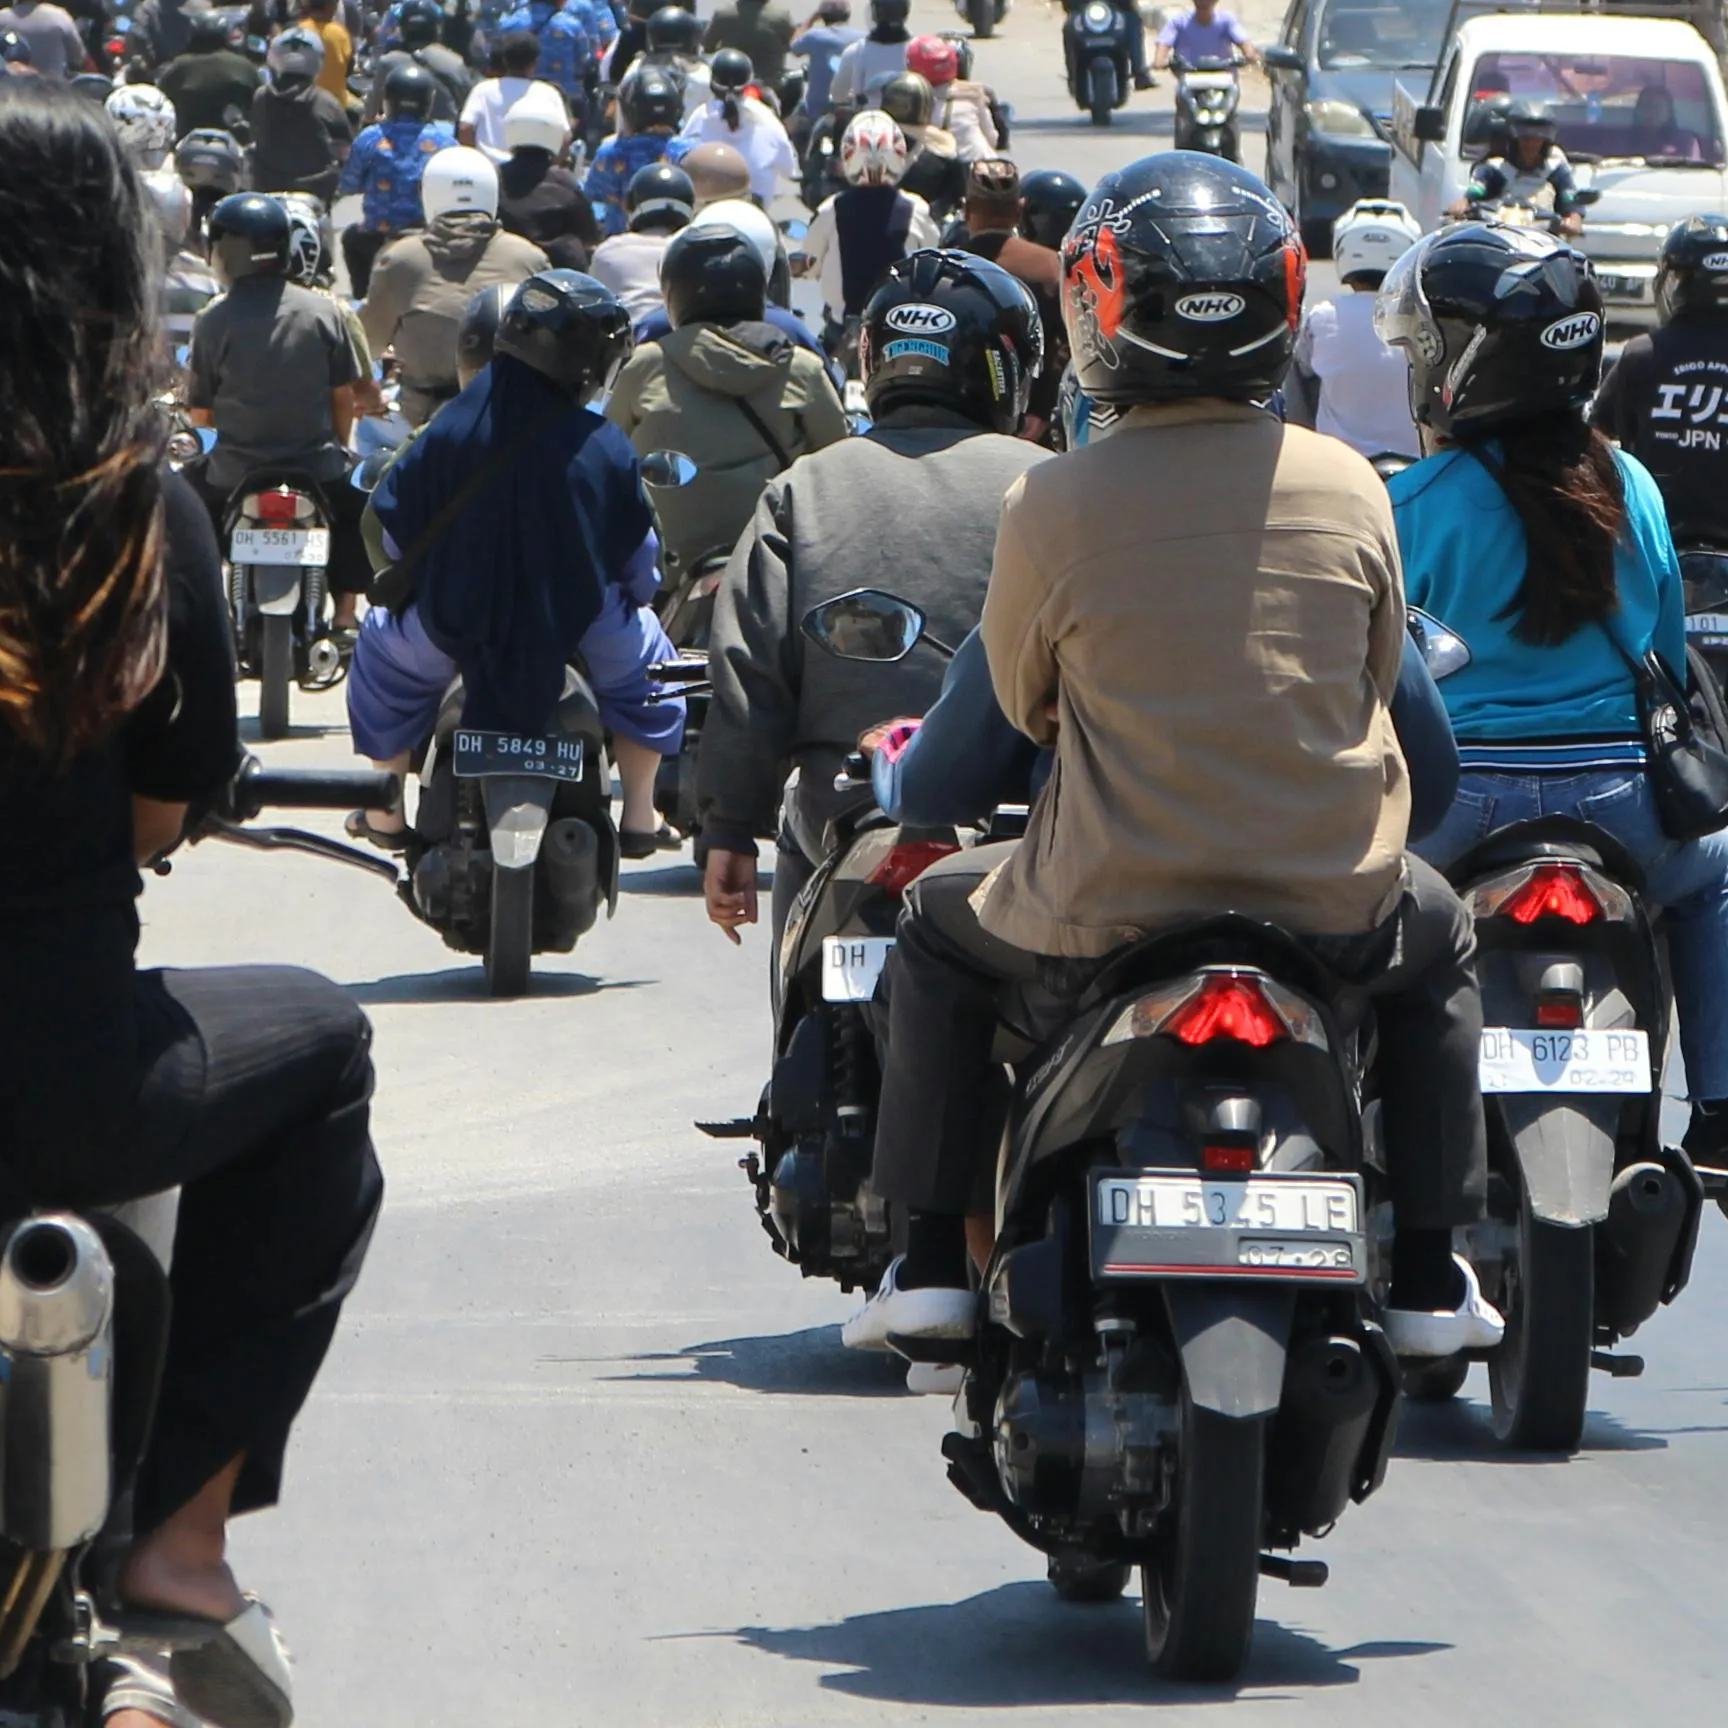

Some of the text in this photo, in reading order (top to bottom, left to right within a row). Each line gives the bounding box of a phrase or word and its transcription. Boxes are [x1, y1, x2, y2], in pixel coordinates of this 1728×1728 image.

[1184, 297, 1234, 315] NHK
[893, 310, 944, 327] NHK
[1552, 316, 1596, 345] NHK
[1679, 429, 1720, 450] JPN
[262, 531, 298, 546] 5561
[458, 734, 581, 761] DH 5849 HU
[832, 944, 865, 968] DH
[1482, 1032, 1640, 1063] DH 6123 PB
[1110, 1187, 1157, 1226] DH
[1302, 1194, 1347, 1232] LE
